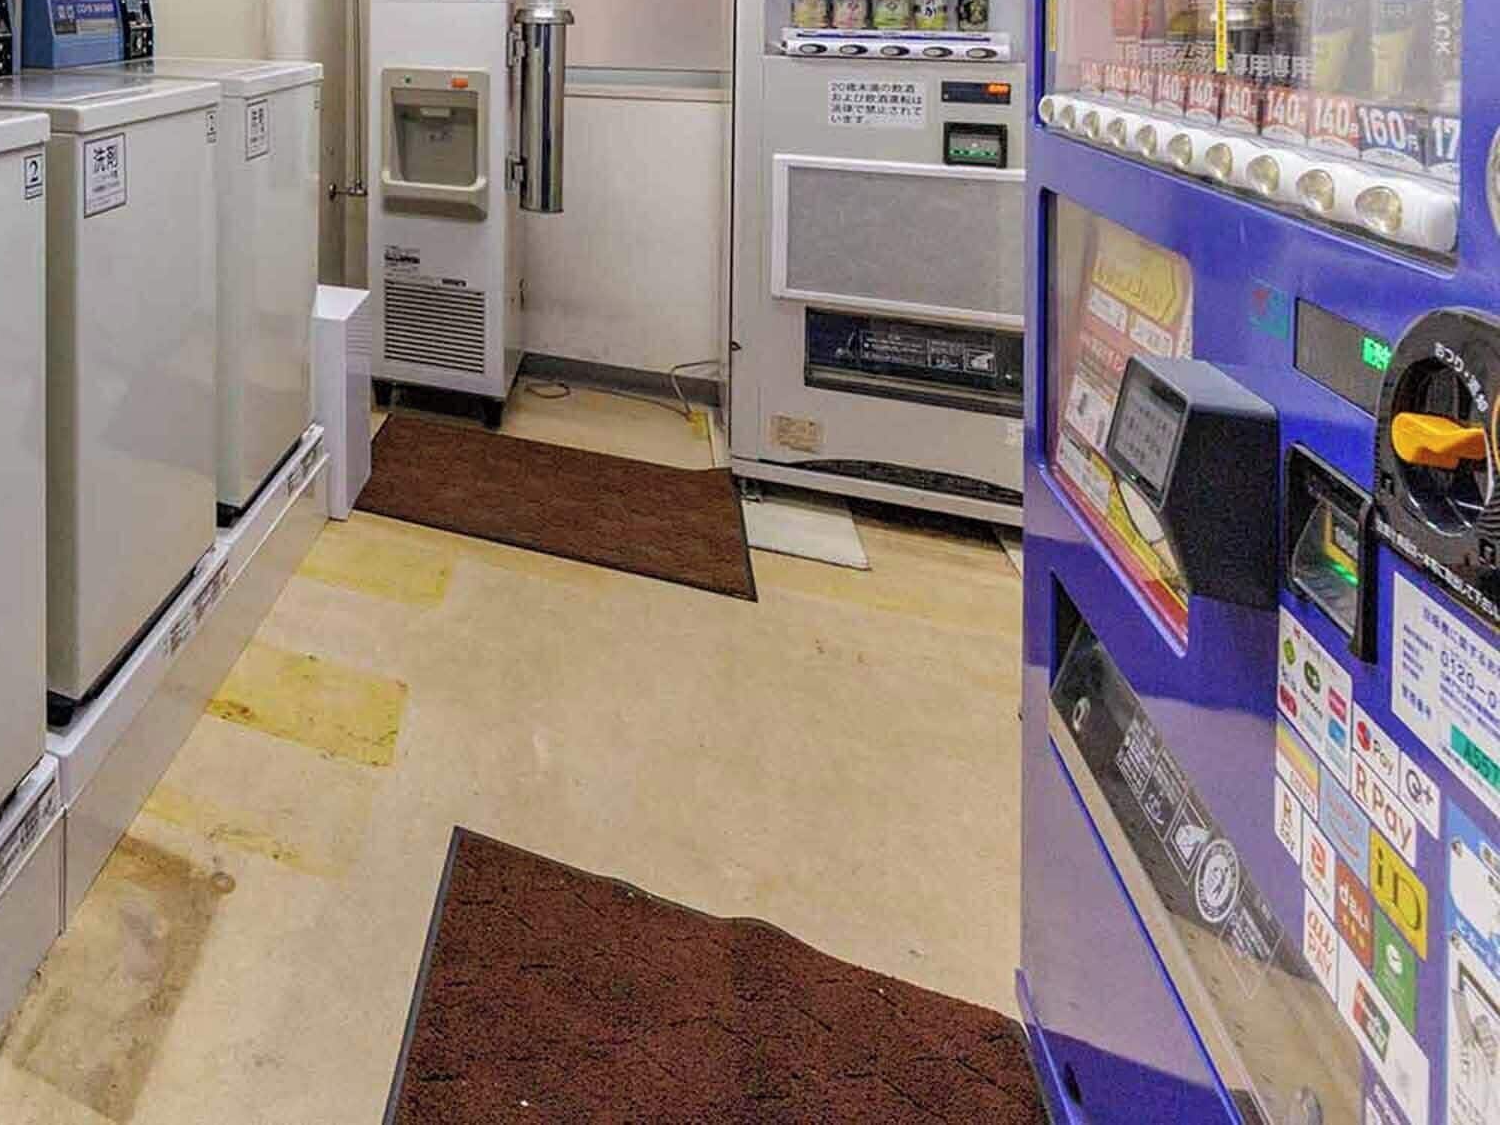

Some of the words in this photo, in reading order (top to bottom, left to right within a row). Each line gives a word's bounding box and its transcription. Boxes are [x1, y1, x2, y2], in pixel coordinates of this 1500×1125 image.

[830, 81, 916, 94] 20歳未満の飲酒
[830, 93, 923, 106] および飲酒運転は
[830, 105, 923, 118] 法律で禁止されて
[28, 160, 40, 183] 2
[1376, 846, 1423, 932] iD
